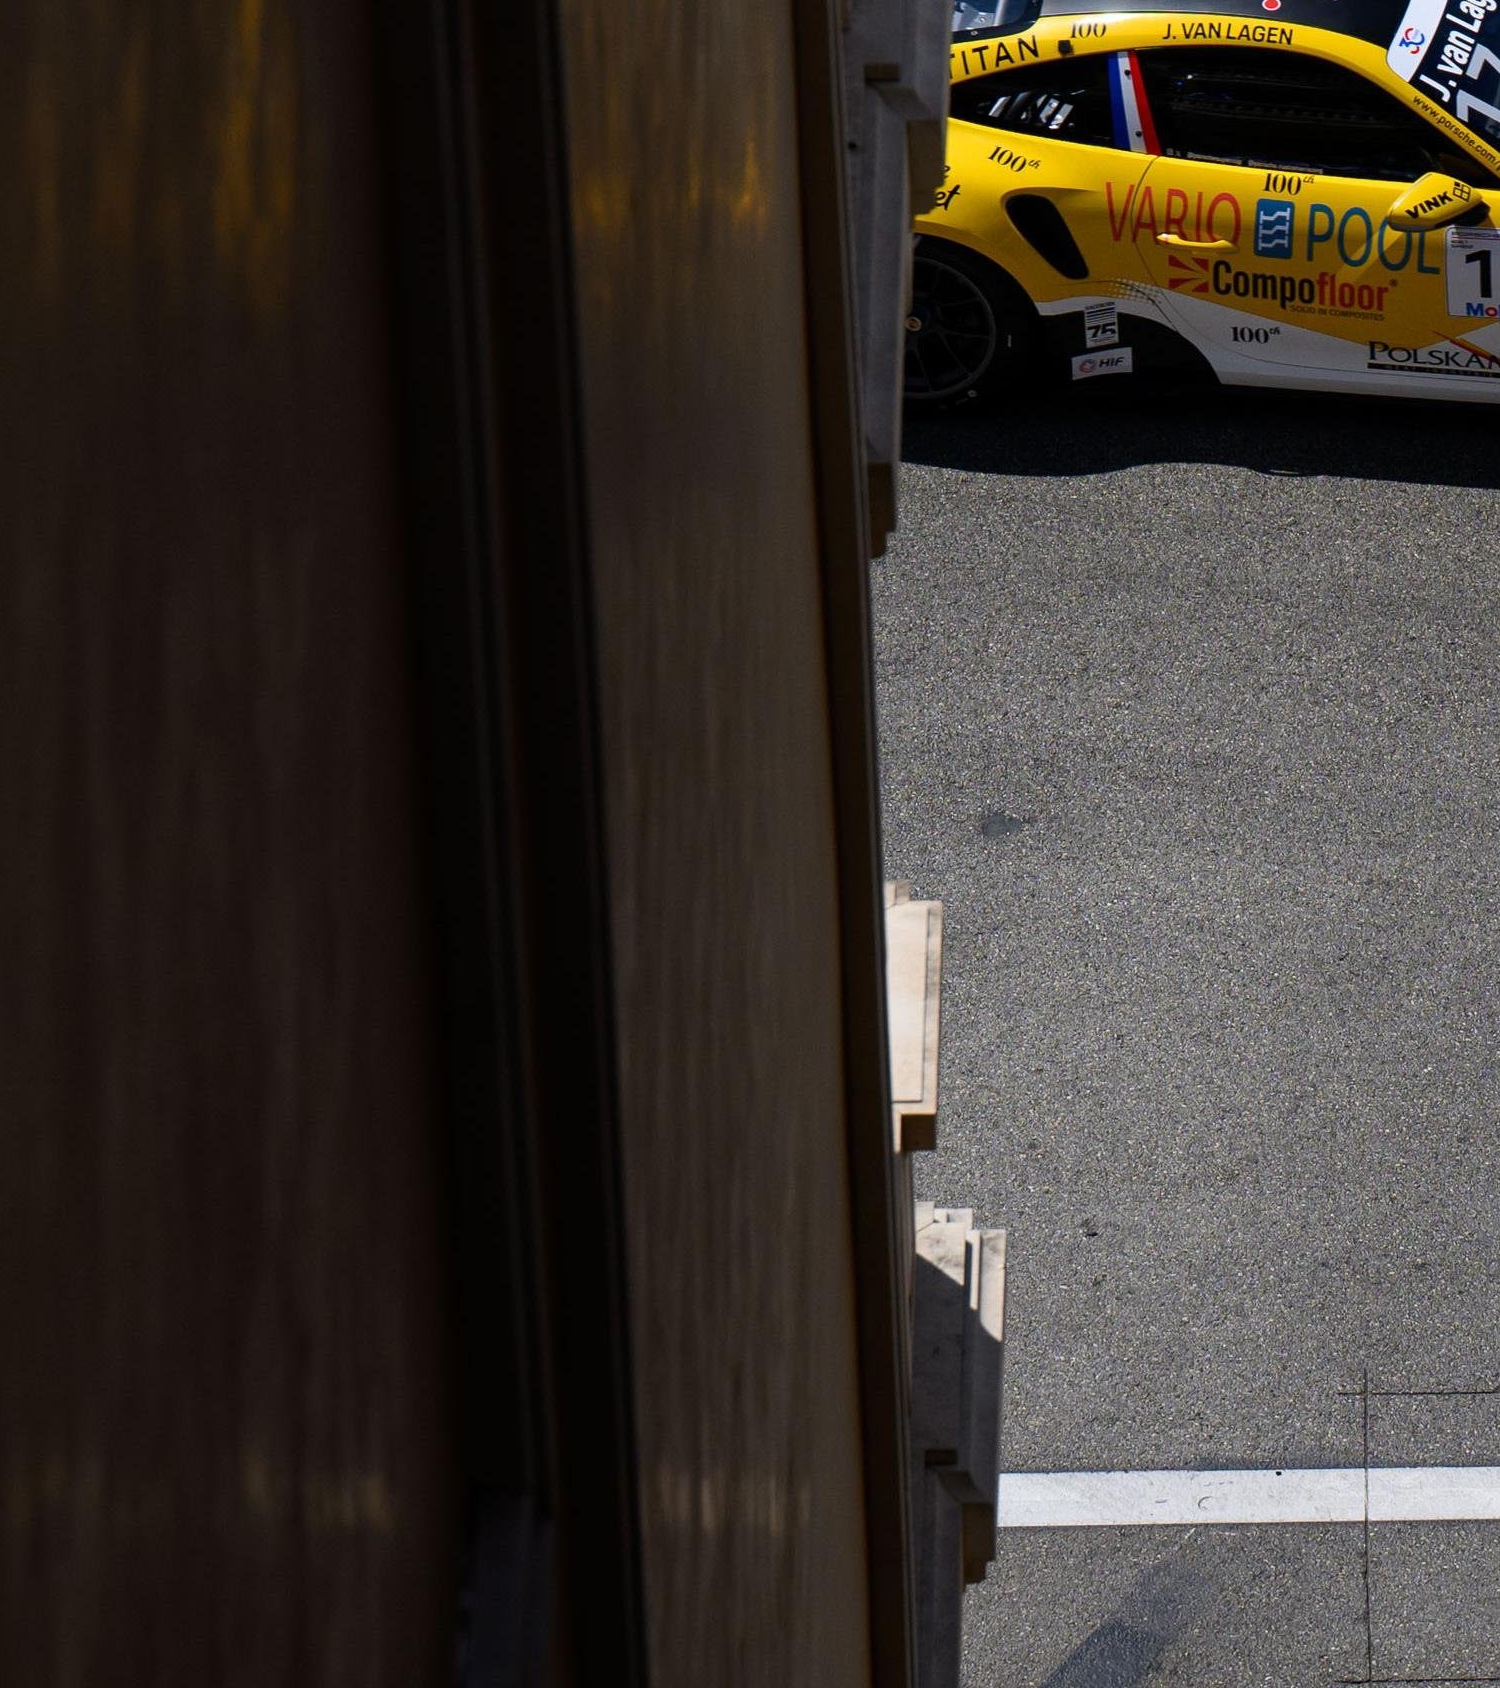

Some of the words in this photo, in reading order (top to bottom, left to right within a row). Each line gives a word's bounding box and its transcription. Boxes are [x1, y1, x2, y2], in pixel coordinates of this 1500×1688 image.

[1162, 23, 1177, 40] J.
[1179, 22, 1222, 40] VAN
[1225, 23, 1294, 45] LAGEN
[1437, 30, 1475, 76] van
[1419, 74, 1457, 103] J.
[987, 145, 1041, 173] 100th
[1263, 173, 1315, 196] 100th
[1405, 190, 1453, 220] VINK
[1104, 181, 1242, 247] VARIO
[1306, 203, 1440, 275] POOL
[1212, 258, 1391, 312] Compofloor
[1087, 322, 1117, 340] 75
[1231, 325, 1281, 345] 100th
[1099, 356, 1125, 369] HIF
